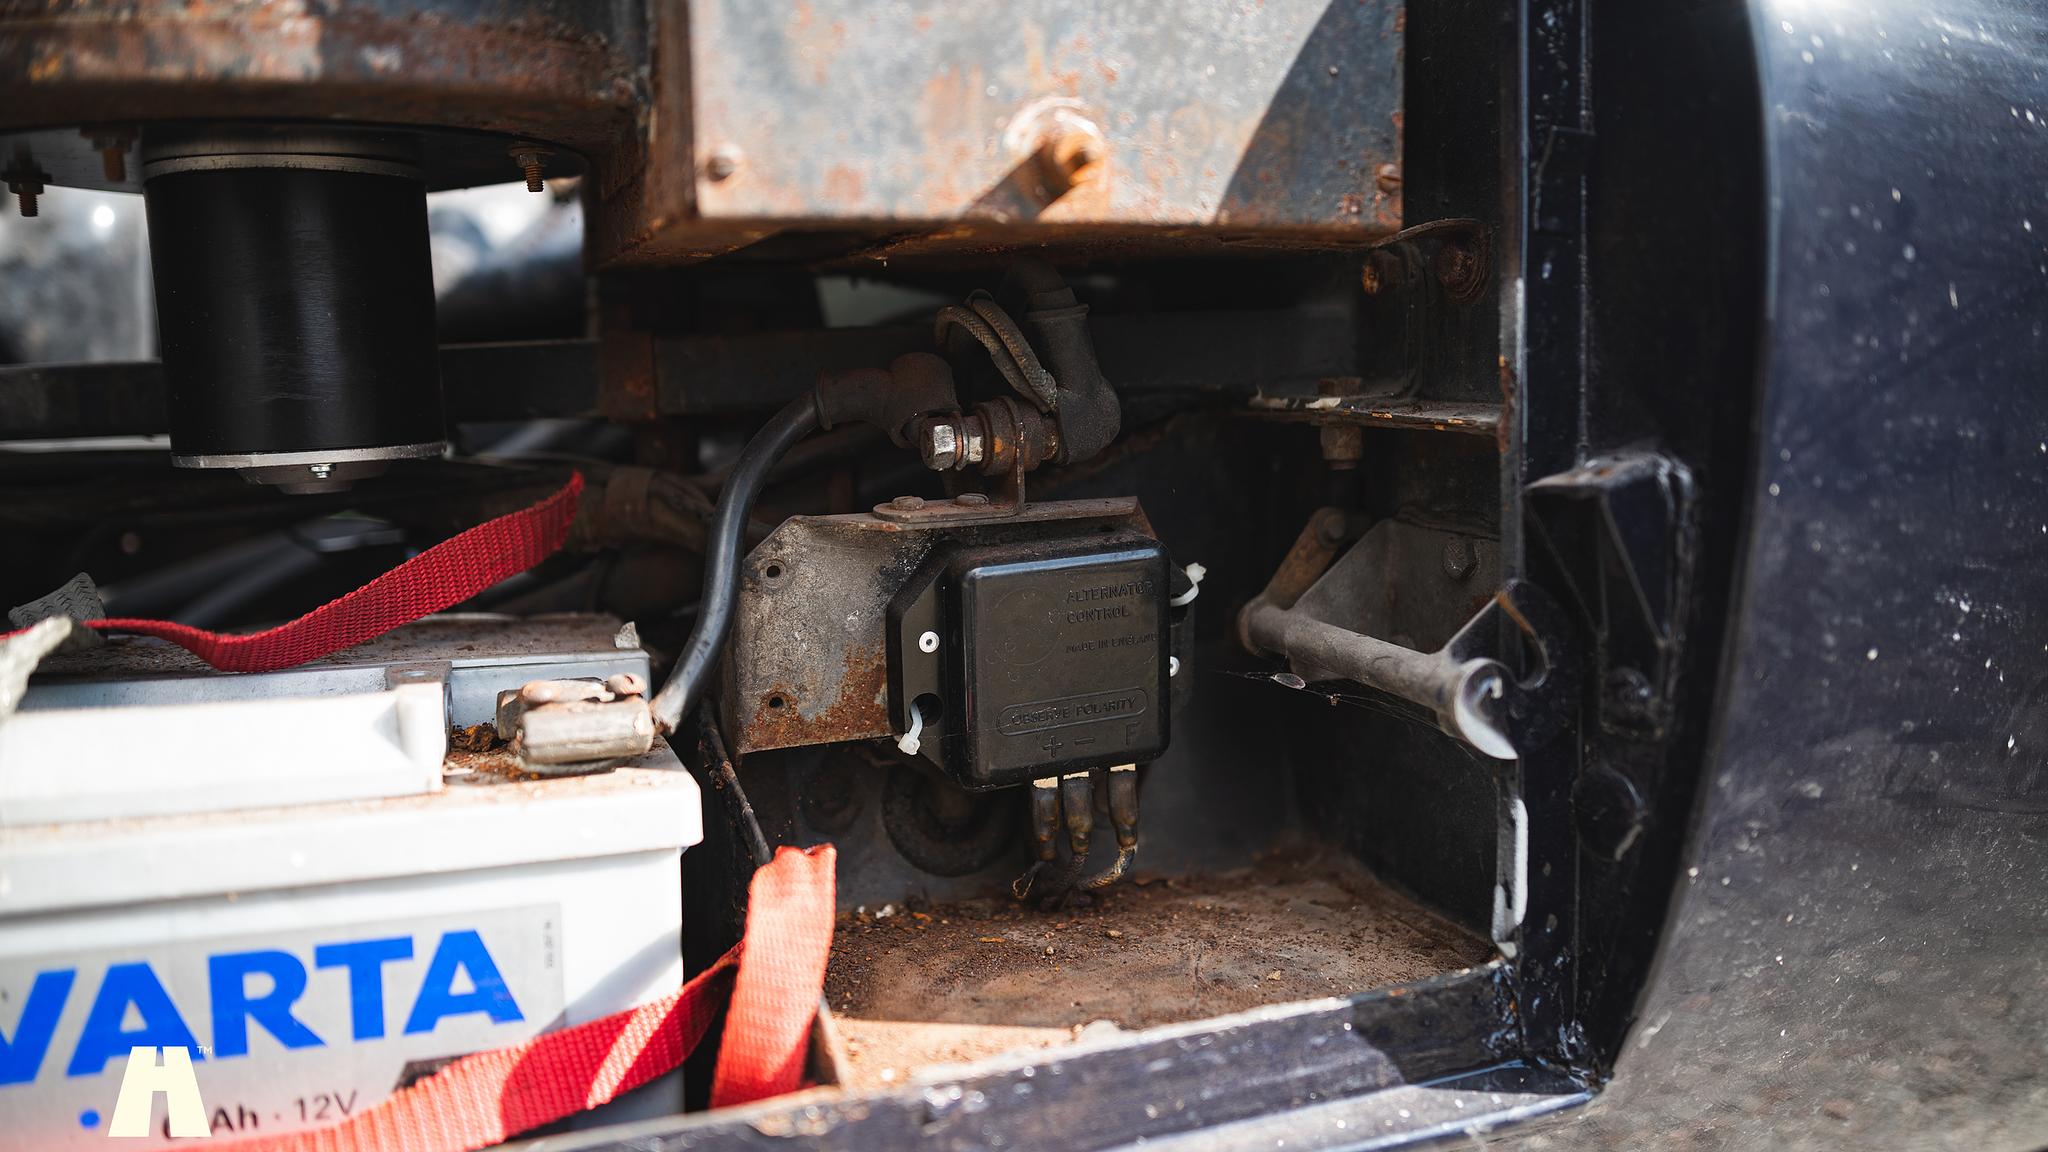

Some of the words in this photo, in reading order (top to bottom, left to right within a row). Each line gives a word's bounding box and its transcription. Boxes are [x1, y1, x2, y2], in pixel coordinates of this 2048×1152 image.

[1067, 582, 1153, 603] ALTERNATOR
[1067, 605, 1129, 623] CONTROL
[1066, 640, 1095, 653] MADE
[1098, 639, 1108, 649] IN
[1011, 707, 1070, 725] OBSERVE
[1077, 697, 1136, 716] POLARITY
[295, 1090, 358, 1121] 12V
